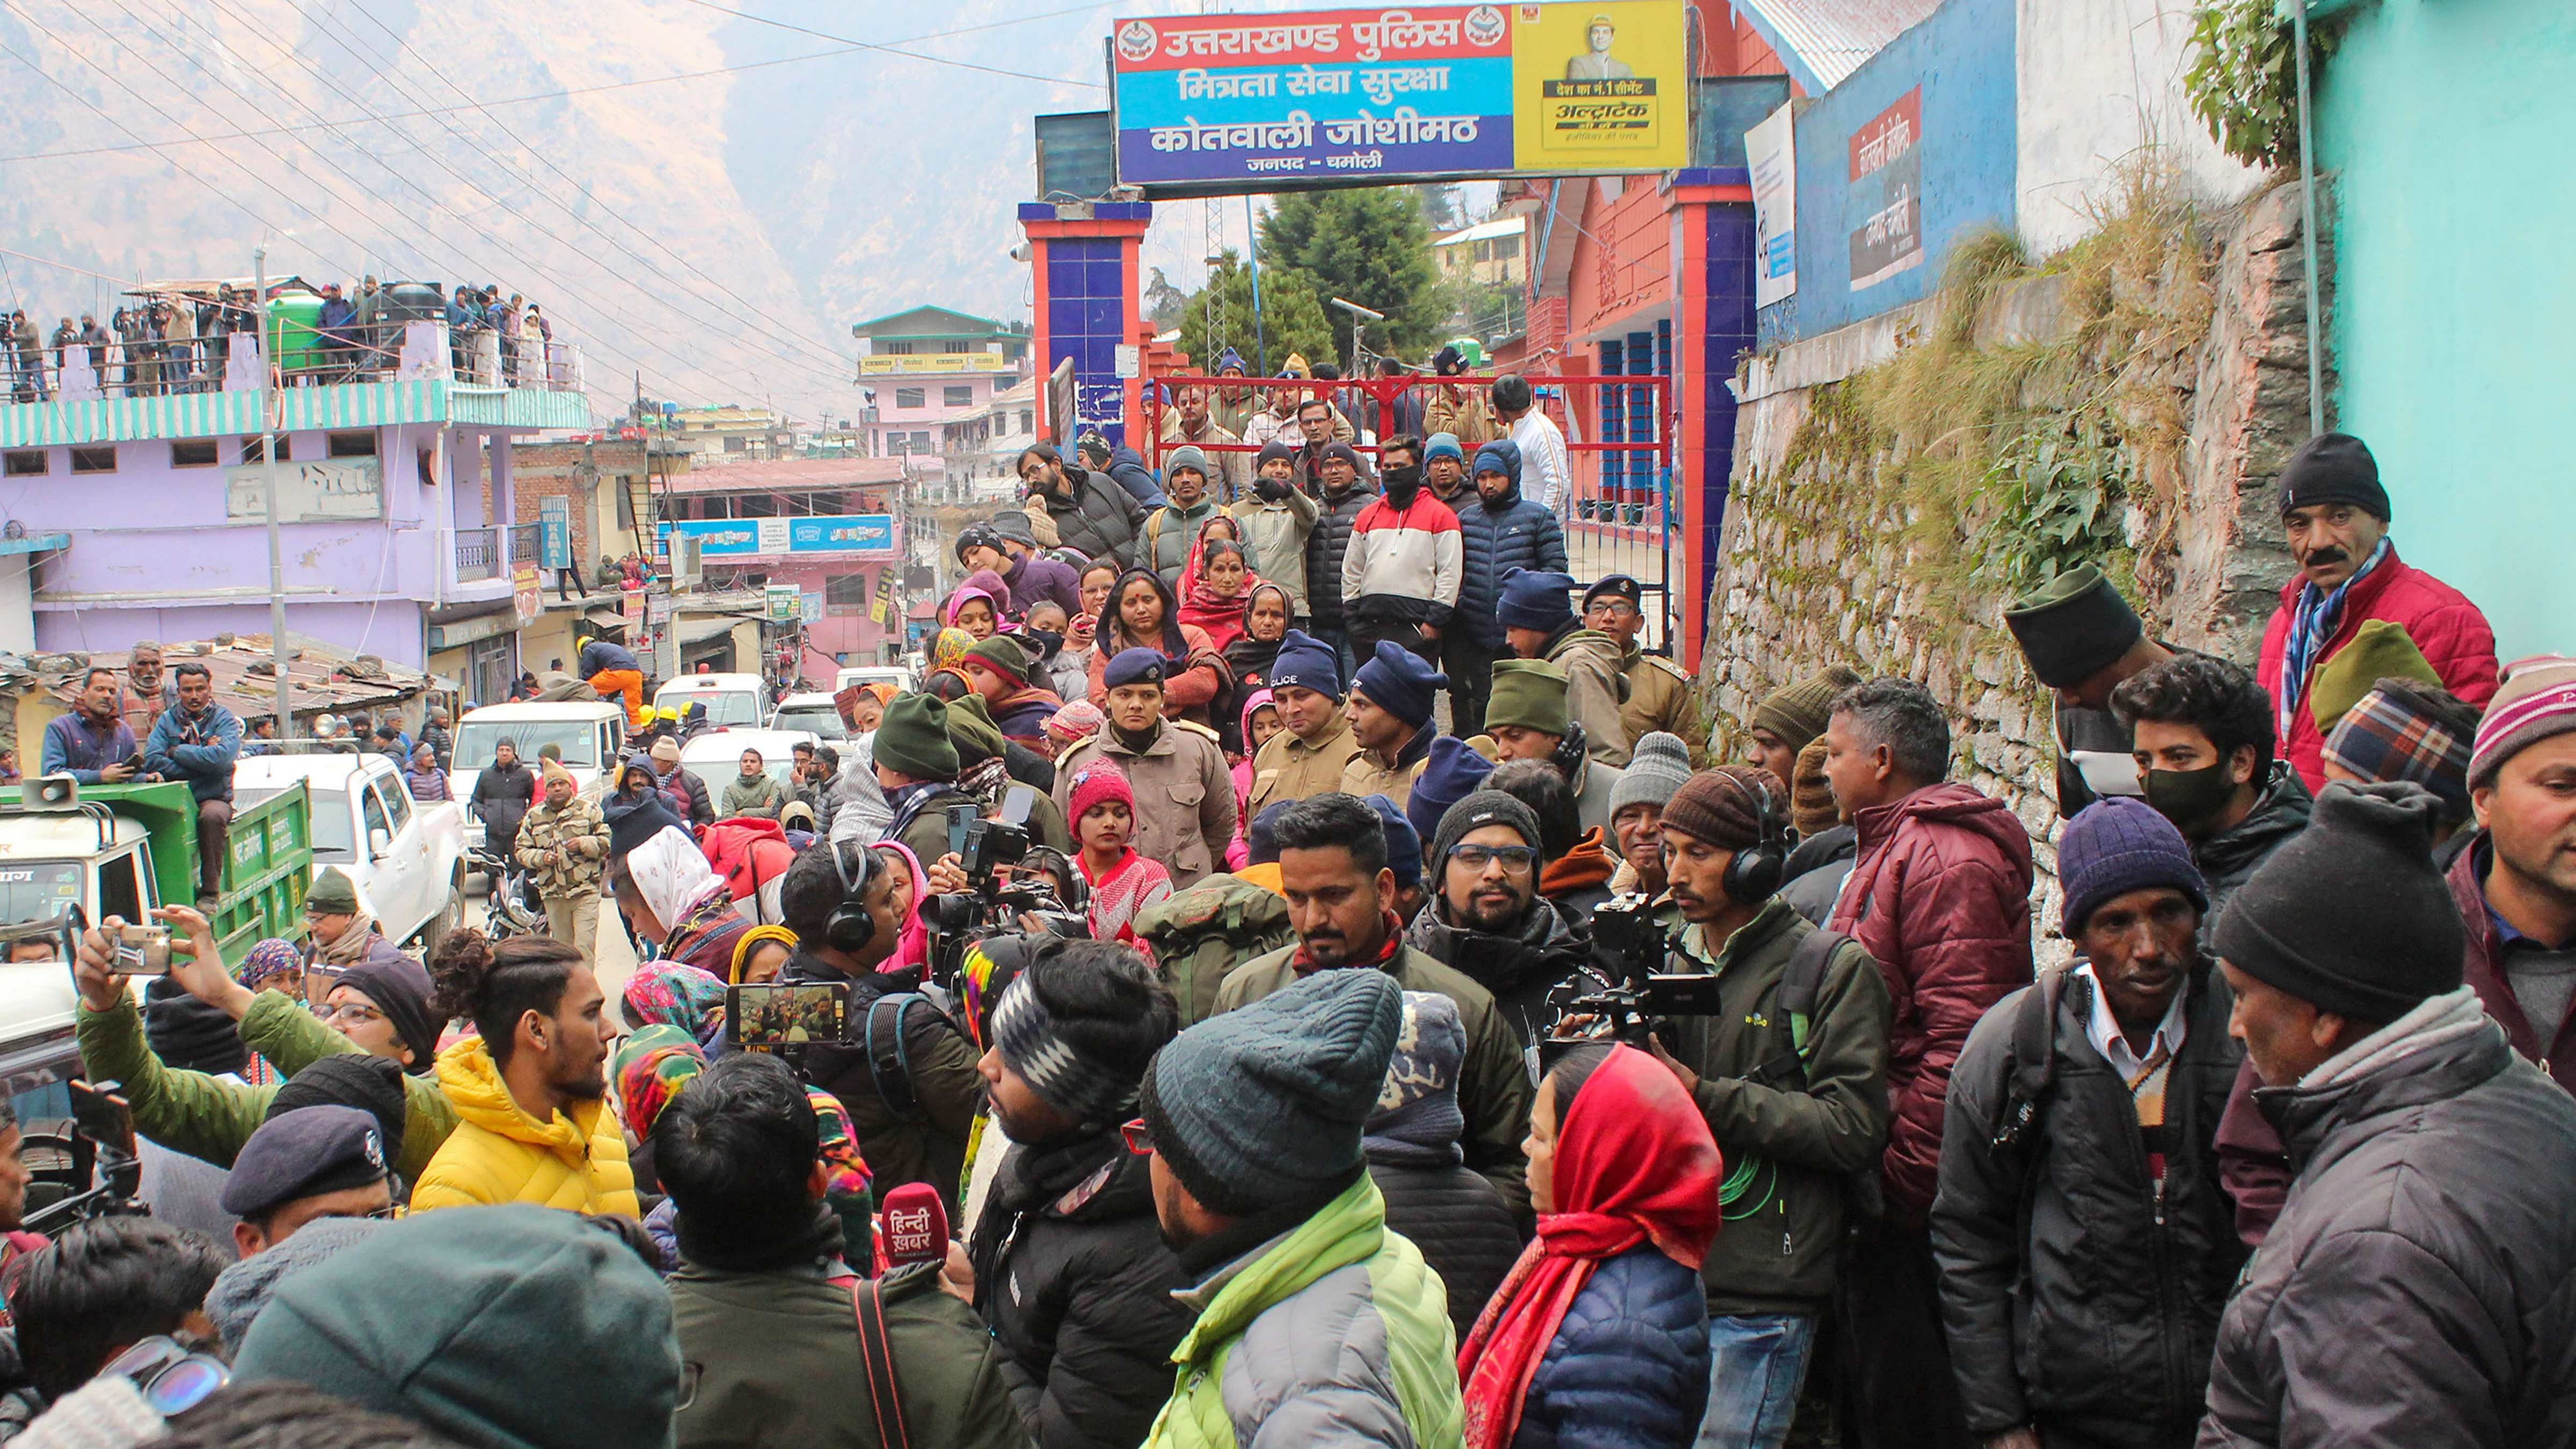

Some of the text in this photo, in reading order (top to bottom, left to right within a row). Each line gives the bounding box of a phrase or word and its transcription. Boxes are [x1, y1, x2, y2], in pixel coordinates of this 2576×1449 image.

[1163, 10, 1462, 62] उत्तराखण्ड पुलिस
[1177, 64, 1449, 105] मित्रता सेवा सुरक्षा
[1576, 84, 1592, 96] का
[1555, 101, 1648, 120] अल्ट्राटेक
[1150, 108, 1480, 152] कोतवाली जोशीमठ
[1246, 157, 1305, 172] जनपद
[1326, 150, 1383, 170] चमोली
[541, 497, 565, 512] HOTEL
[542, 512, 564, 523] NEW
[1271, 675, 1298, 687] OLICE
[889, 1208, 930, 1234] हिन्दी
[891, 1232, 931, 1253] ख़बर
